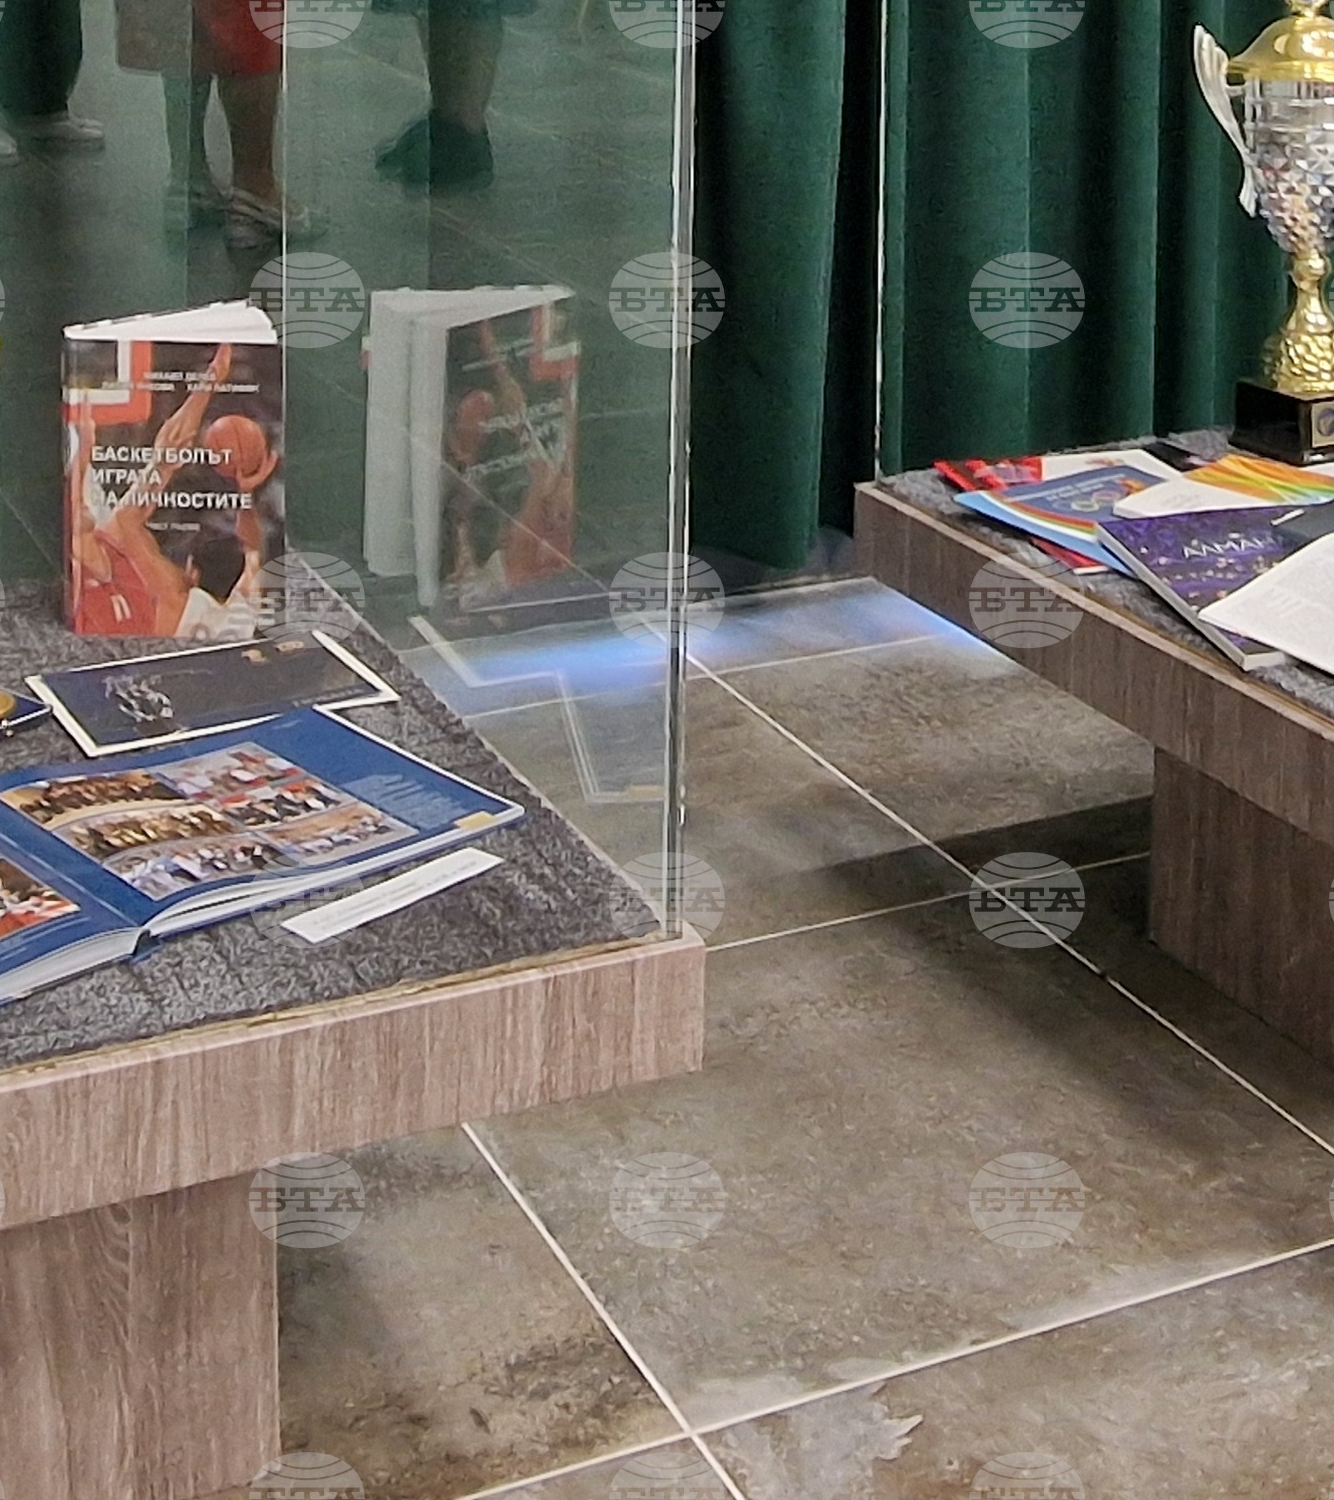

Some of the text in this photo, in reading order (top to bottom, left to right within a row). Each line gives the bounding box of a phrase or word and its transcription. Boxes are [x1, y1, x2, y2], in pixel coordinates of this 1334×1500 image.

[91, 446, 233, 465] БАСКЕТБОЛЪТ
[91, 469, 162, 485] ИГРАТА
[126, 491, 253, 510] ЛИЧНОСТИТЕ
